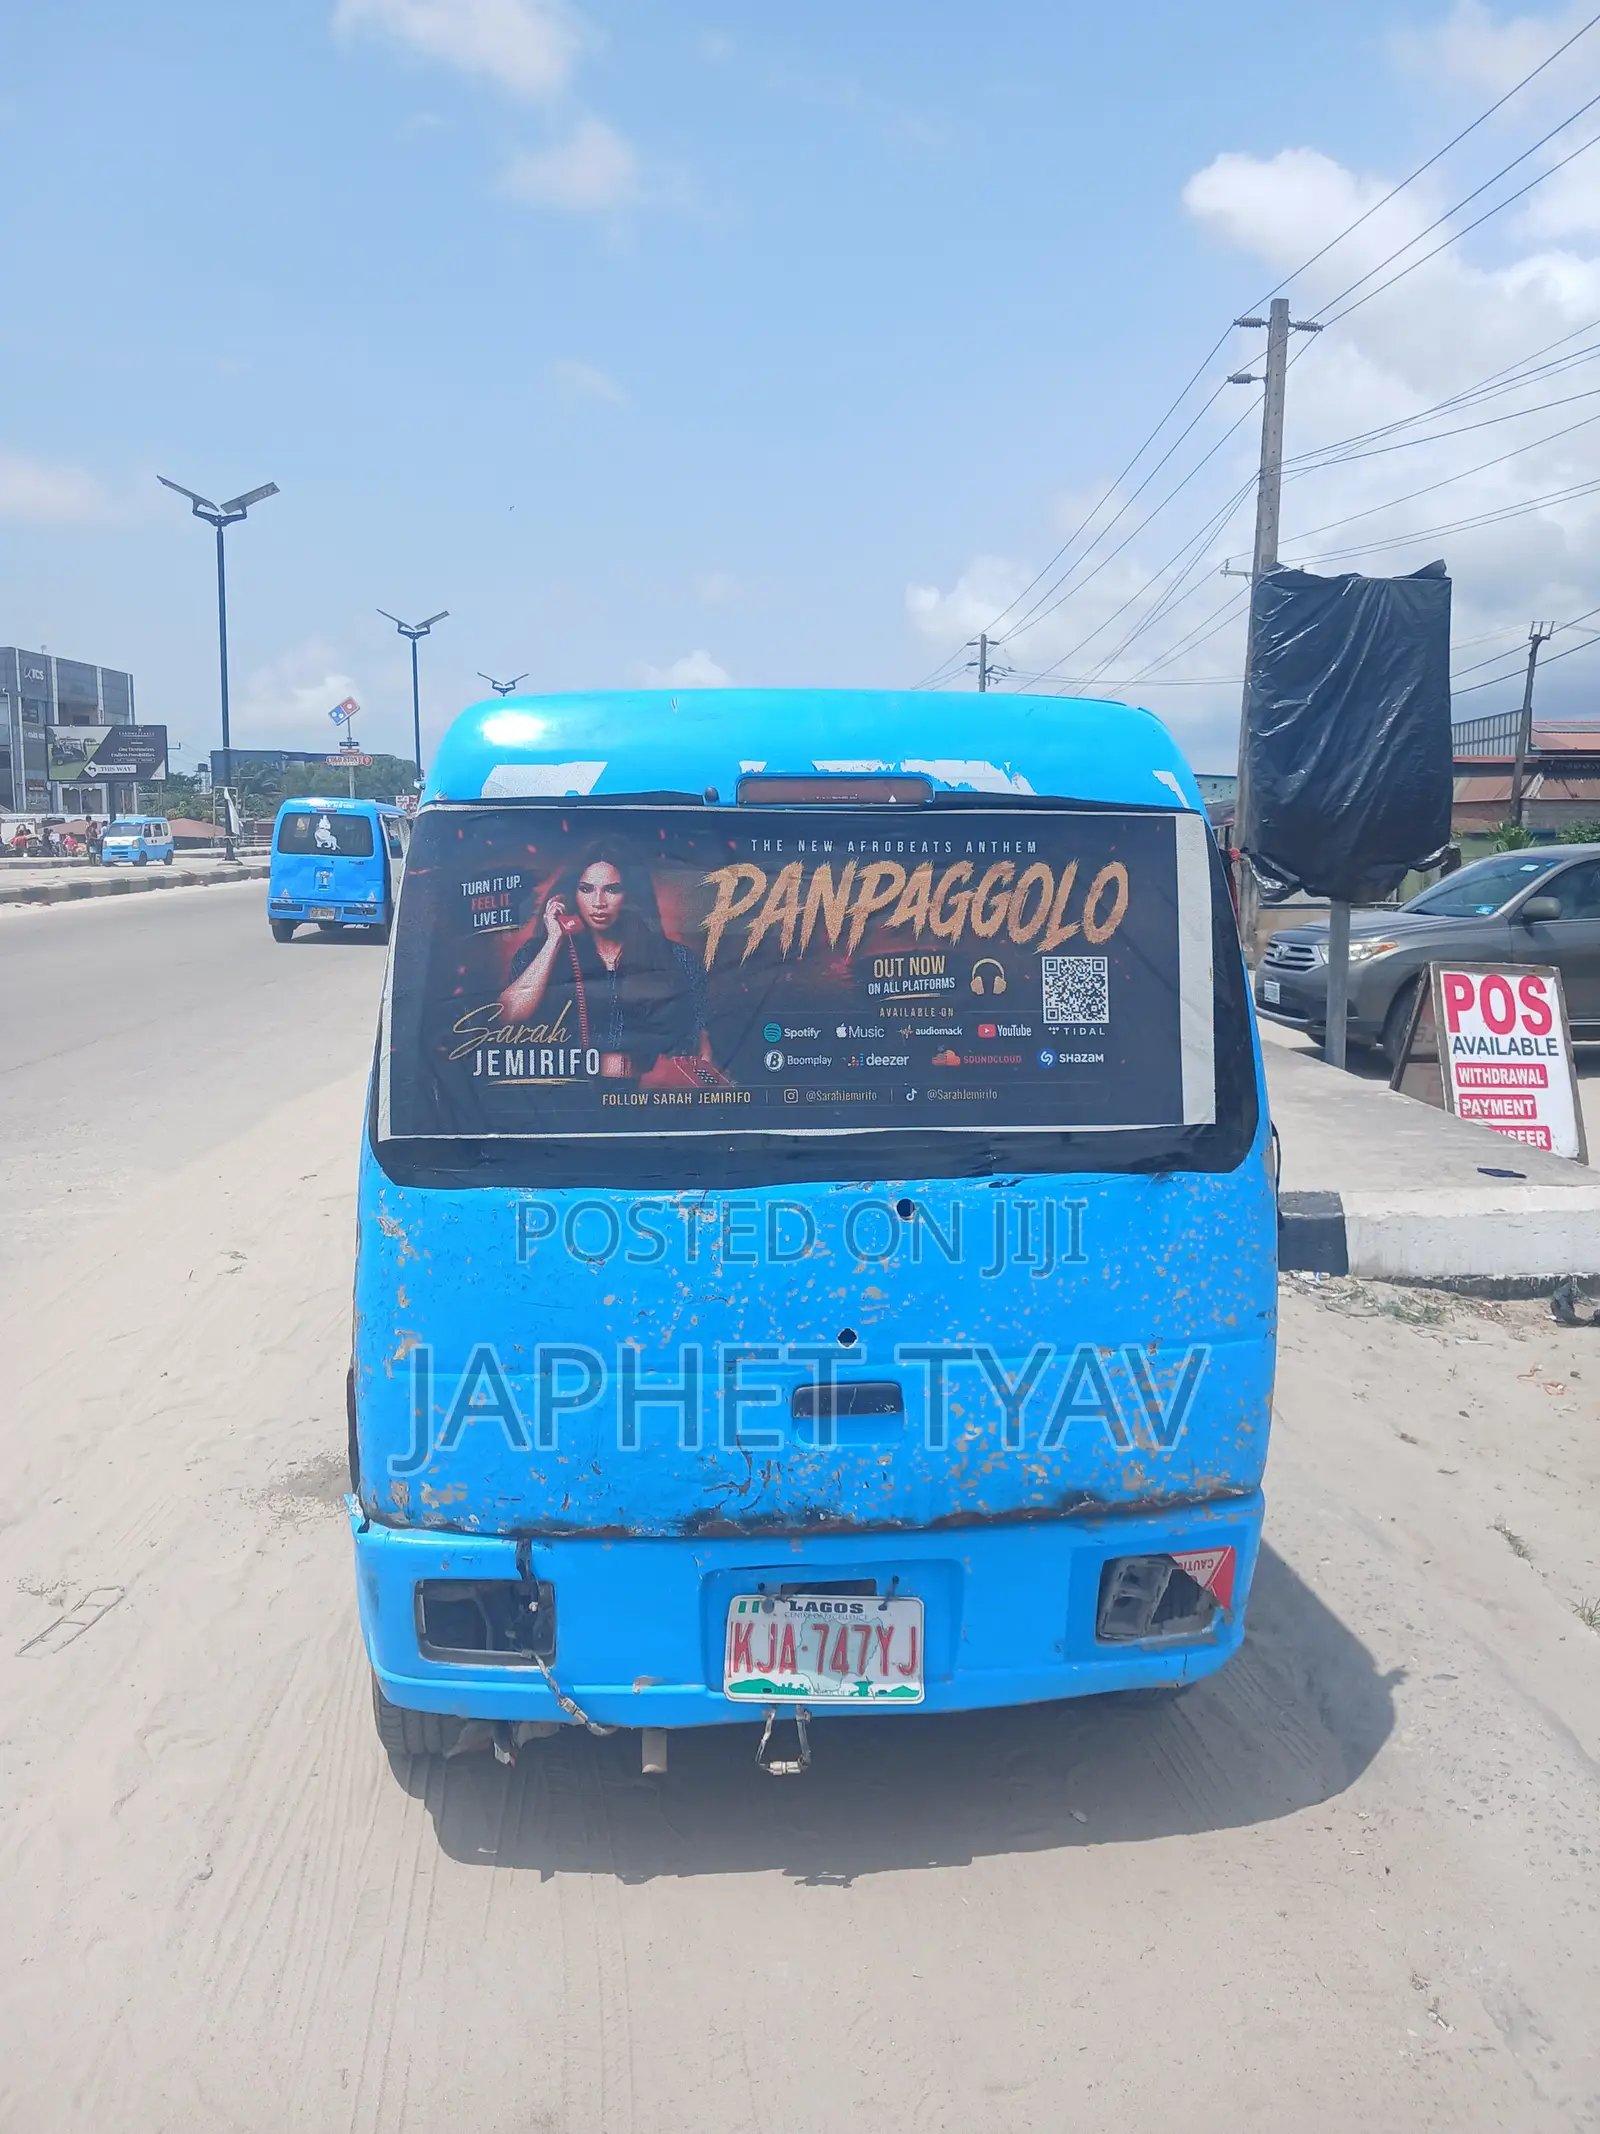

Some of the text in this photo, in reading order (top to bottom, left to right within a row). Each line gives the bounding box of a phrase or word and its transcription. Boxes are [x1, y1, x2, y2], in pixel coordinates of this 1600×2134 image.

[752, 839, 1037, 853] THE NEW AFROBEATS ANTHEM
[461, 874, 522, 896] TURN IT UP.
[471, 896, 497, 911] FEEL
[473, 909, 513, 927] LIVE IT.
[698, 858, 1129, 973] PANPAGGOLO
[873, 955, 946, 978] OUT NOW
[868, 977, 956, 995] ON ALL PLATFORMS
[879, 1006, 954, 1017] AVAILABLE ON
[1443, 974, 1553, 1036] POS
[449, 999, 573, 1061] Sarah
[784, 1026, 822, 1040] Spotify
[848, 1025, 885, 1038] Music
[915, 1024, 963, 1036] audiomack
[997, 1024, 1032, 1037] YouTube
[1063, 1027, 1106, 1036] TIDAL
[1452, 1036, 1560, 1056] AVAILABLE
[472, 1048, 600, 1076] JEMIRIFO
[787, 1055, 833, 1069] Boomplay
[866, 1053, 910, 1066] deezer
[963, 1055, 1022, 1064] SOUNDCLOUD
[1458, 1067, 1545, 1085] WITHDRAWAL
[602, 1092, 751, 1106] FOLLOW SARAH JEMIRIFO
[1462, 1099, 1534, 1117] PAYMENT
[789, 1600, 864, 1614] LAGOS
